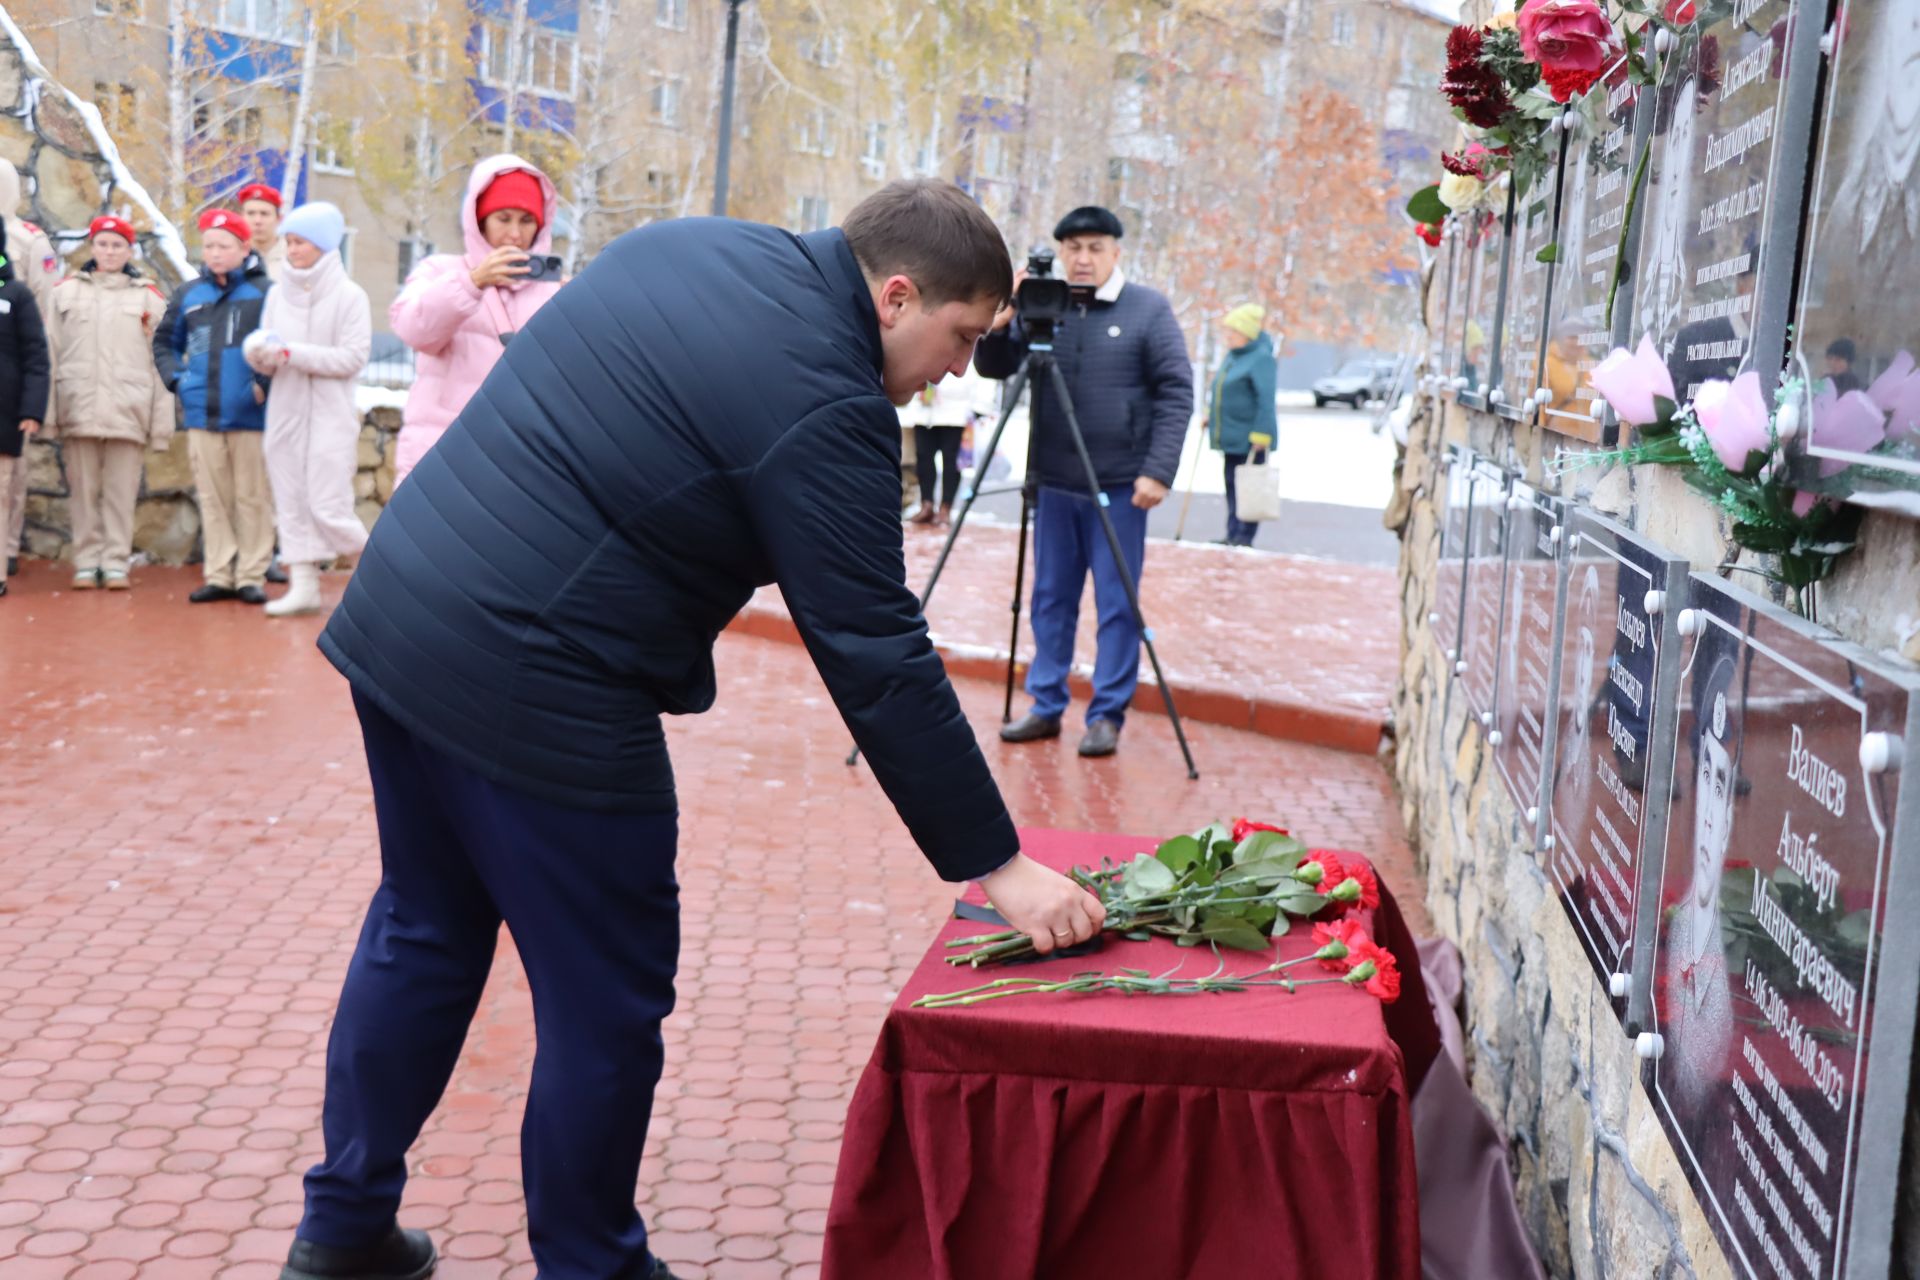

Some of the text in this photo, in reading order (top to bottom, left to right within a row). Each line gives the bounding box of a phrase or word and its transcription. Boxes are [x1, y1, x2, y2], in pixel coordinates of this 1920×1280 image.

[1720, 38, 1773, 102] Александр
[1704, 106, 1774, 173] Владимирович
[1617, 594, 1646, 653] Козырев
[1610, 649, 1643, 717] Александр
[1607, 702, 1637, 763] Юрьевич
[1787, 724, 1847, 818] Валиев
[1777, 811, 1840, 914] Альберт
[1750, 867, 1857, 1029] Минигараевич
[1744, 958, 1845, 1112] 14.06.2003-06.08.2023
[1743, 1036, 1829, 1175] ПОГИБ ПРИ ПРОВЕДЕНИИ
[1732, 1068, 1833, 1241] БОЕВЫХ ДЕЙСТВИЙ ВО ВРЕМЯ
[1732, 1119, 1821, 1280] УЧАСТИЯ В СПЕЦИАЛЬНОЙ
[1734, 1177, 1766, 1248] ВОЕННОЙ
